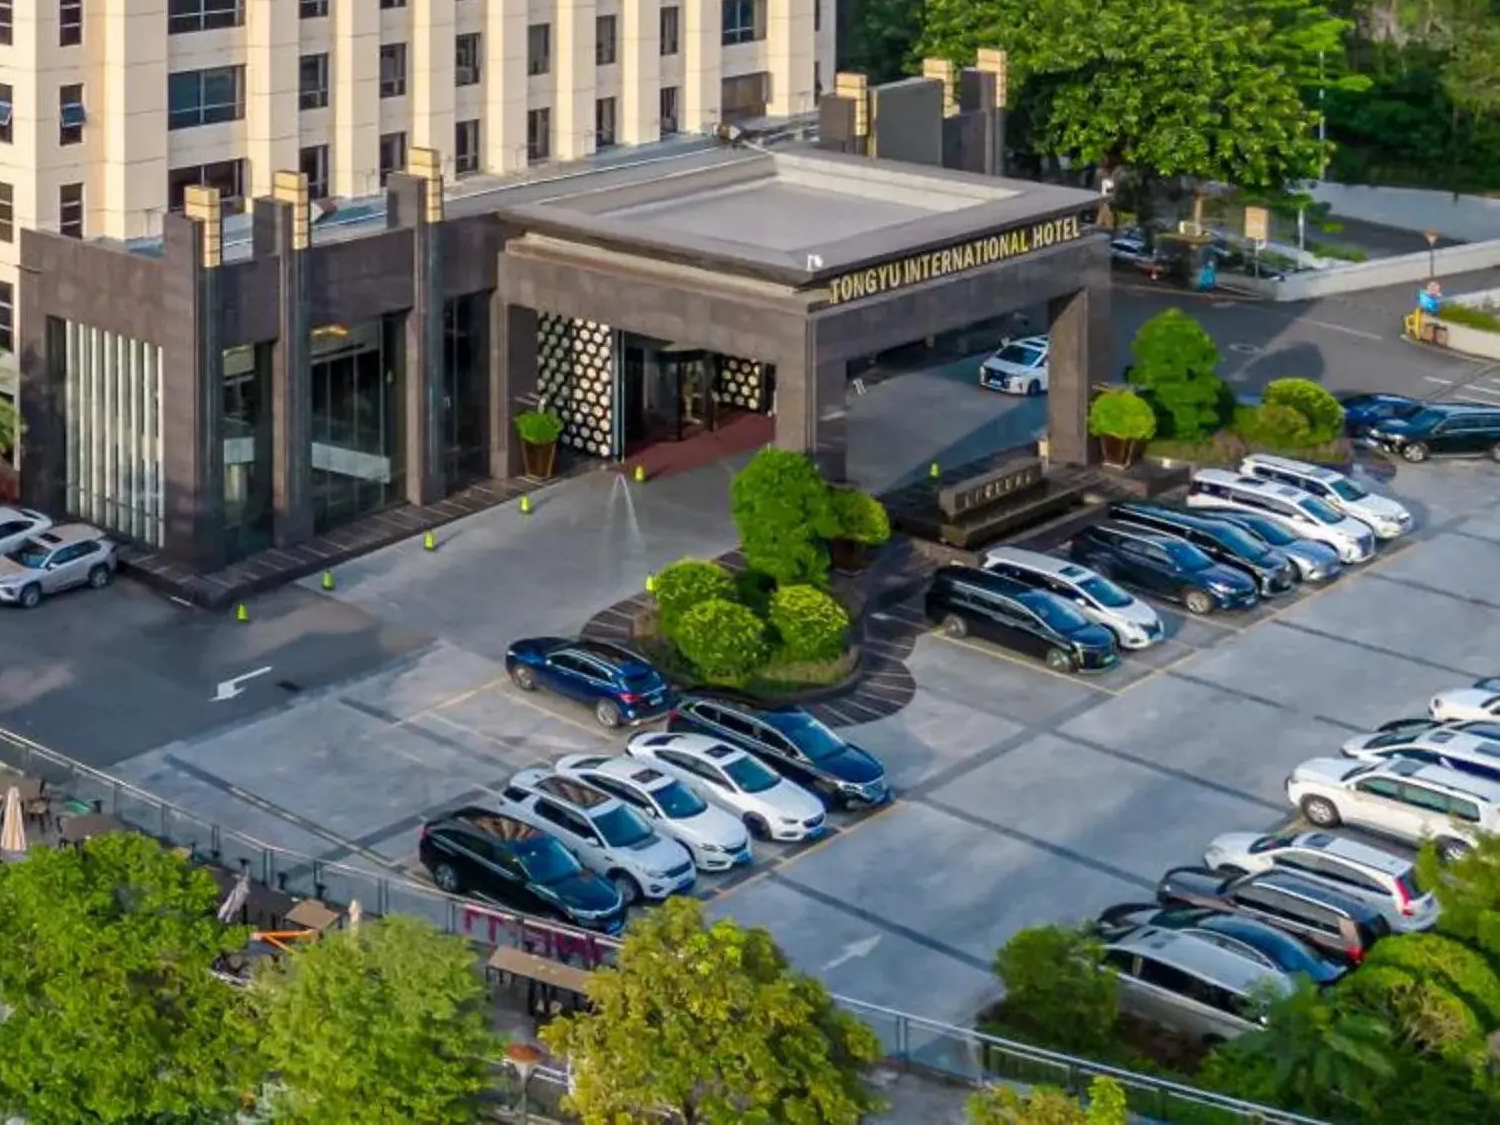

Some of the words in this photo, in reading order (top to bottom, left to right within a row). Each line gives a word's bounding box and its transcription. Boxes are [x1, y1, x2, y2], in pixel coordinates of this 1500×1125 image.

[830, 266, 901, 304] TONGYU
[903, 229, 1029, 283] INTERNATIONAL
[1032, 216, 1081, 249] HOTEL
